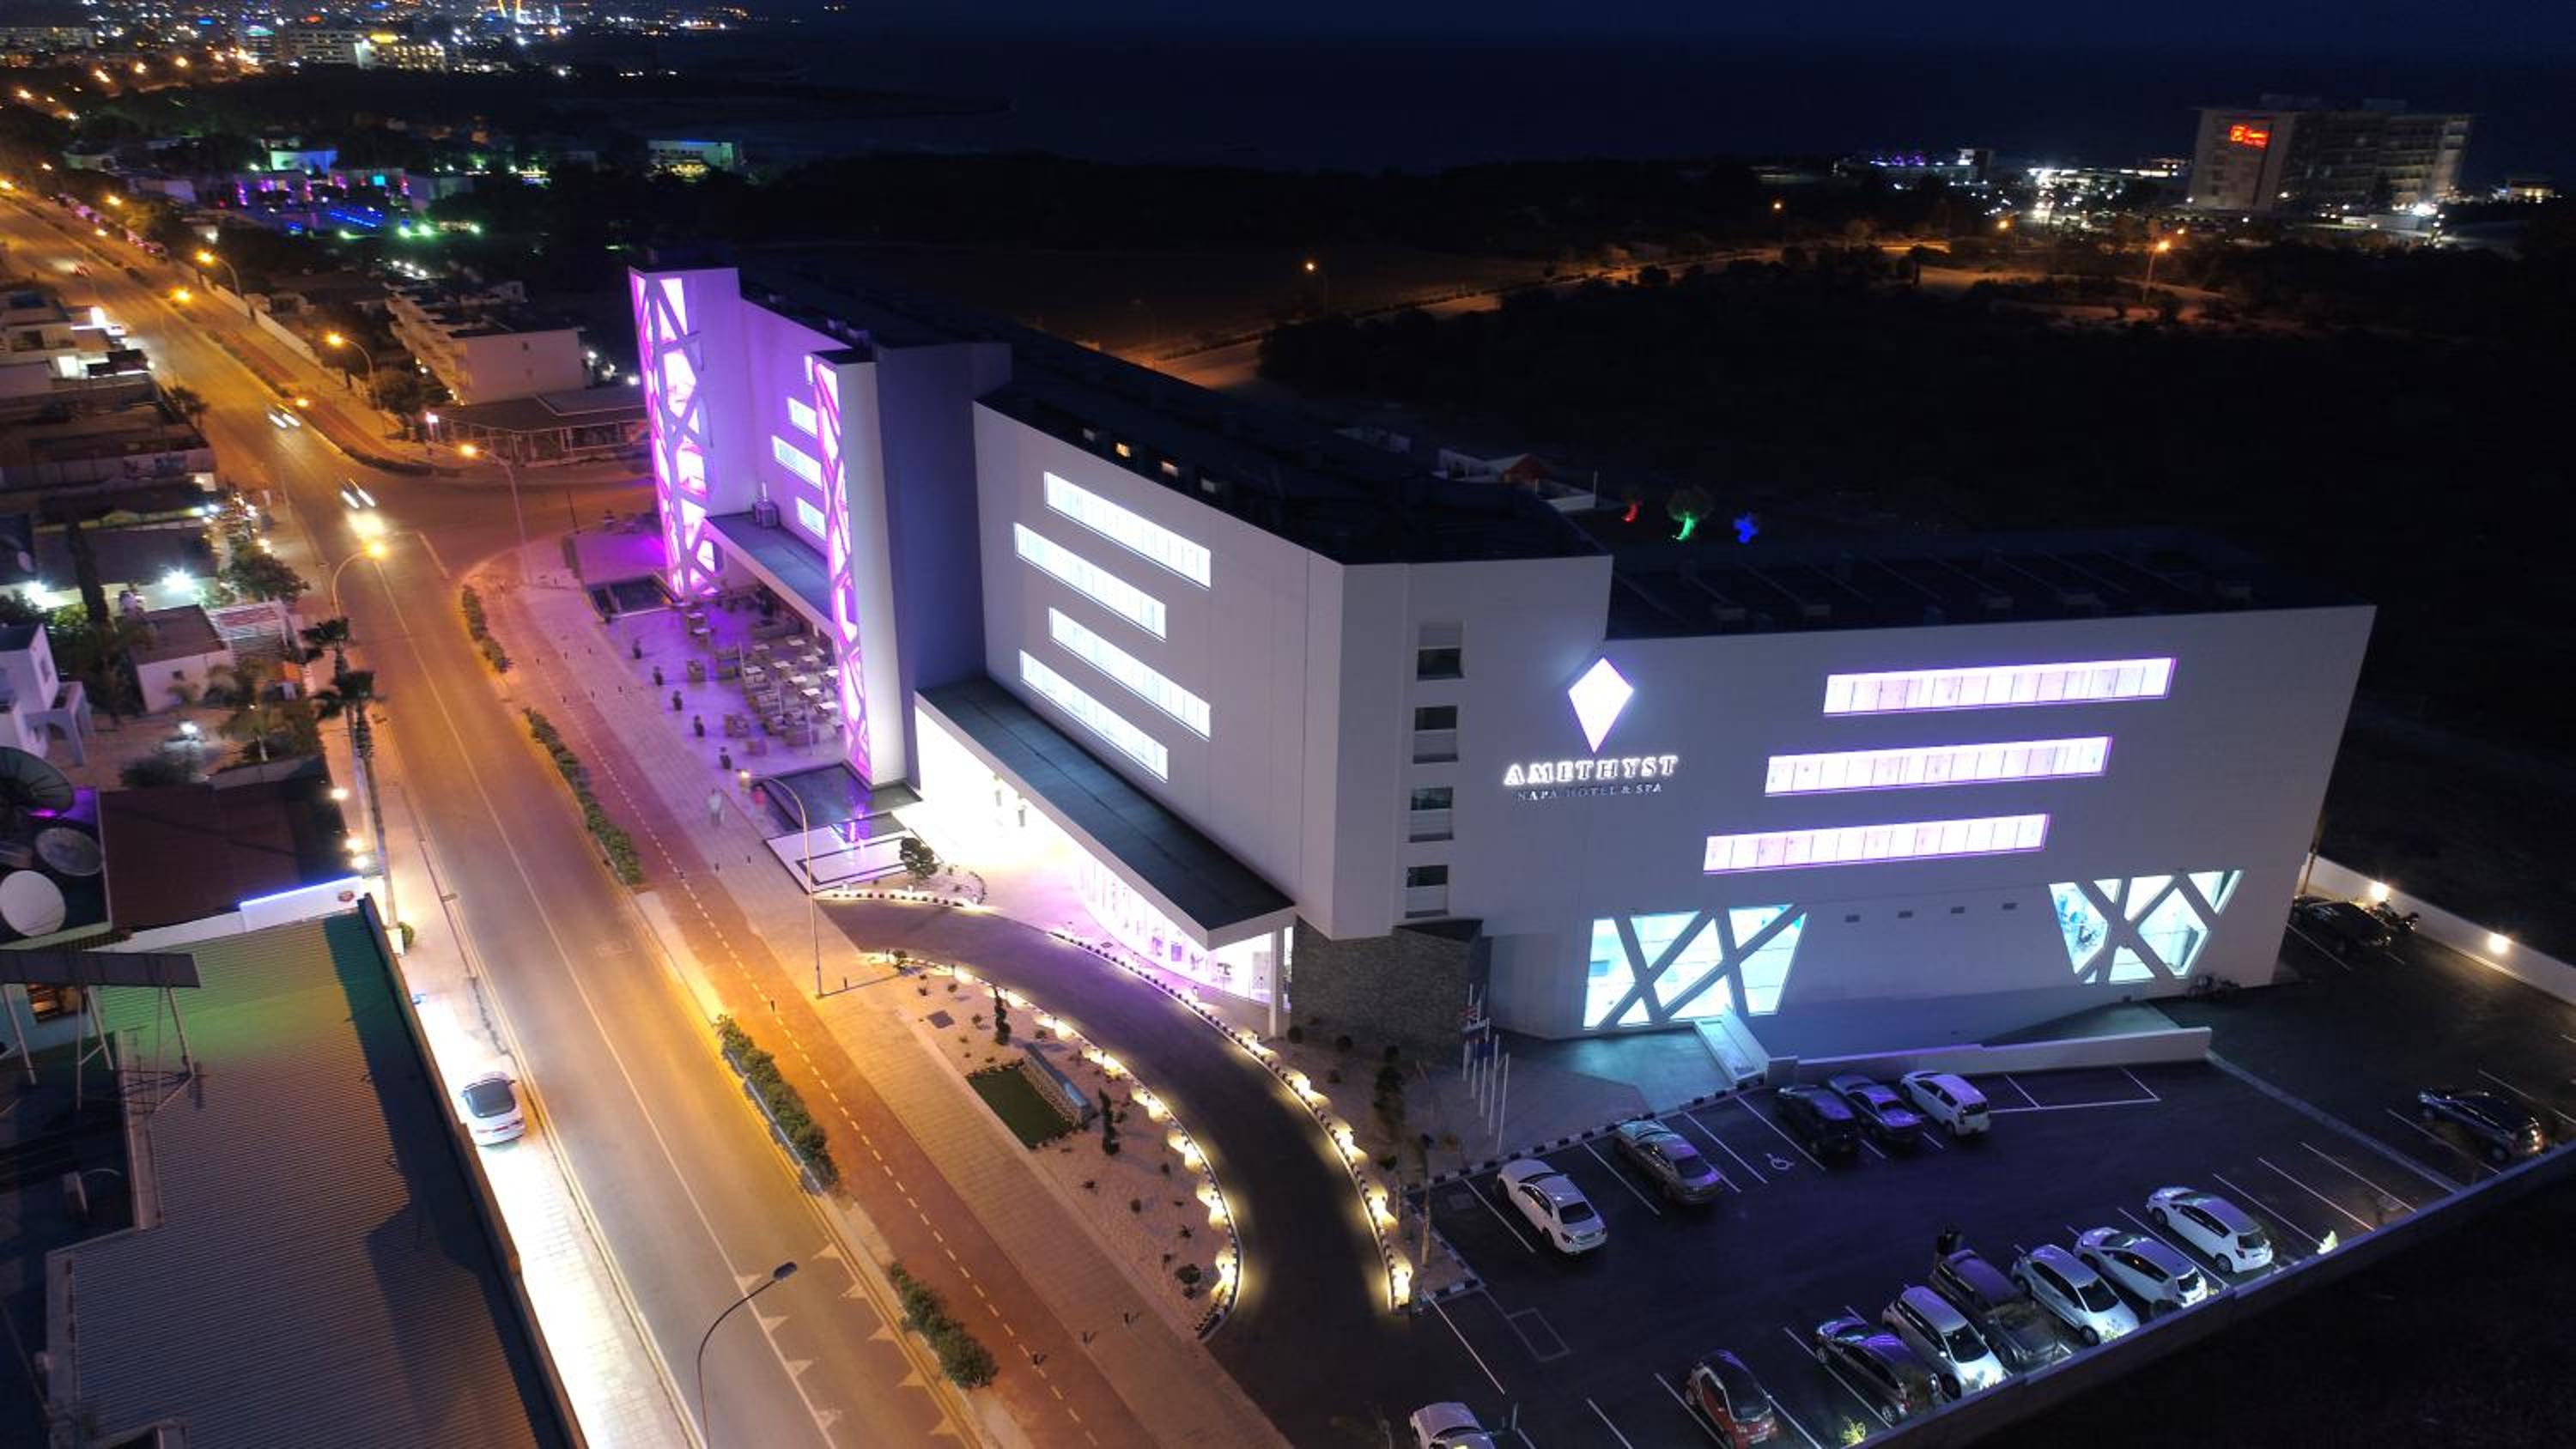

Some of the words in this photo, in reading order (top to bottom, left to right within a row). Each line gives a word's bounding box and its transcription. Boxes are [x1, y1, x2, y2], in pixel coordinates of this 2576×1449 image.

[1504, 755, 1678, 785] AMETHYST
[1517, 789, 1558, 801] NAPA
[1565, 786, 1615, 797] HOTEL
[1621, 785, 1631, 794] &
[1635, 782, 1662, 794] SPA
